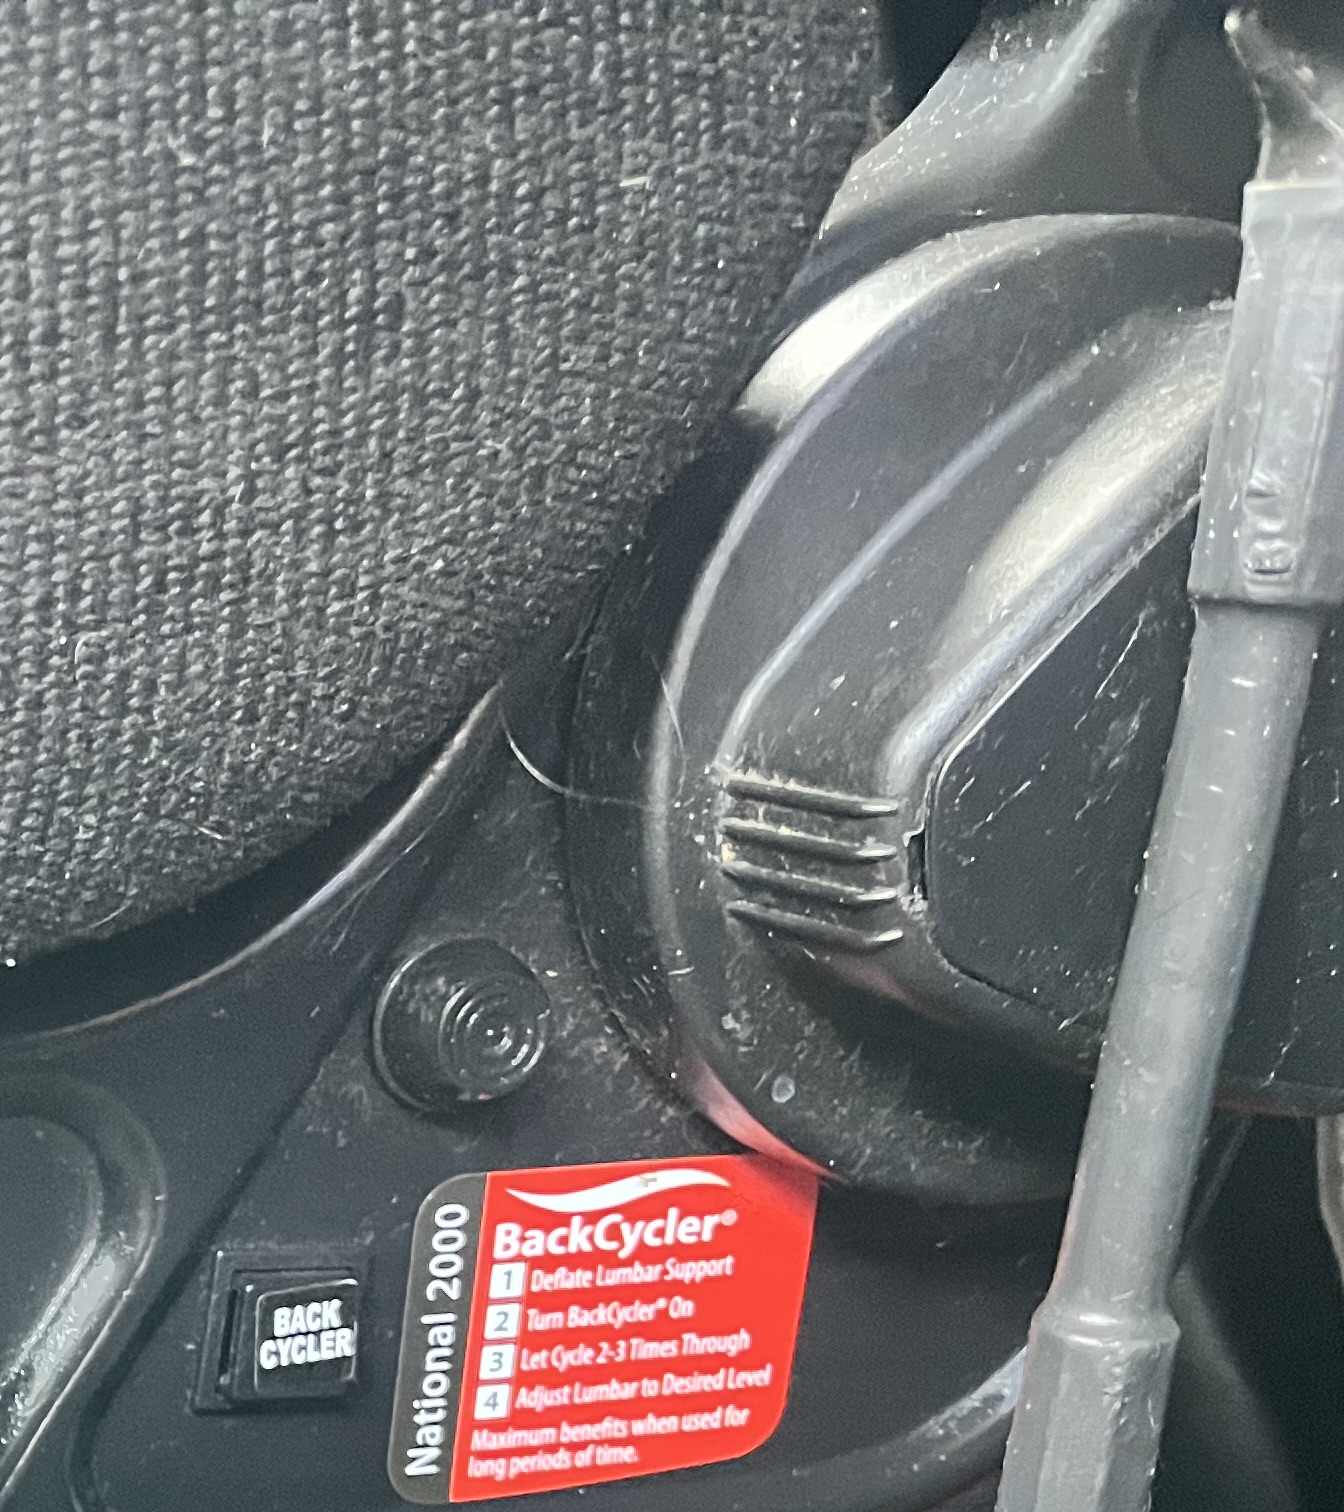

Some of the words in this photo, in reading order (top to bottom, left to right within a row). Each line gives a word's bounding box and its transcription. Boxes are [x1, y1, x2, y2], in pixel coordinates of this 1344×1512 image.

[426, 1203, 470, 1302] 2000
[503, 1269, 513, 1291] 1
[530, 1266, 593, 1292] Deflate
[596, 1260, 662, 1287] Lumbar
[663, 1254, 734, 1284] Support
[273, 1298, 342, 1338] BACK
[493, 1311, 510, 1332] 2
[527, 1308, 564, 1331] Turn
[669, 1295, 694, 1319] On
[260, 1327, 356, 1370] CYCLER
[488, 1351, 504, 1373] 3
[520, 1347, 550, 1371] Let
[551, 1343, 595, 1373] Cycle
[595, 1339, 627, 1364] 2-3
[629, 1337, 679, 1361] Times
[681, 1327, 752, 1357] Through
[404, 1312, 458, 1477] National
[483, 1391, 499, 1412] 4
[515, 1385, 572, 1412] Adjust
[573, 1377, 640, 1404] Lumbar
[641, 1377, 659, 1398] to
[661, 1367, 726, 1396] Desired
[727, 1362, 773, 1389] Level
[470, 1427, 558, 1452] Maximum
[559, 1415, 629, 1443] benefits
[631, 1412, 680, 1436] when
[681, 1405, 724, 1432] used
[724, 1403, 751, 1427] for
[467, 1455, 507, 1482] long
[509, 1448, 572, 1480] periods
[574, 1443, 595, 1468] of
[595, 1444, 639, 1466] time.
